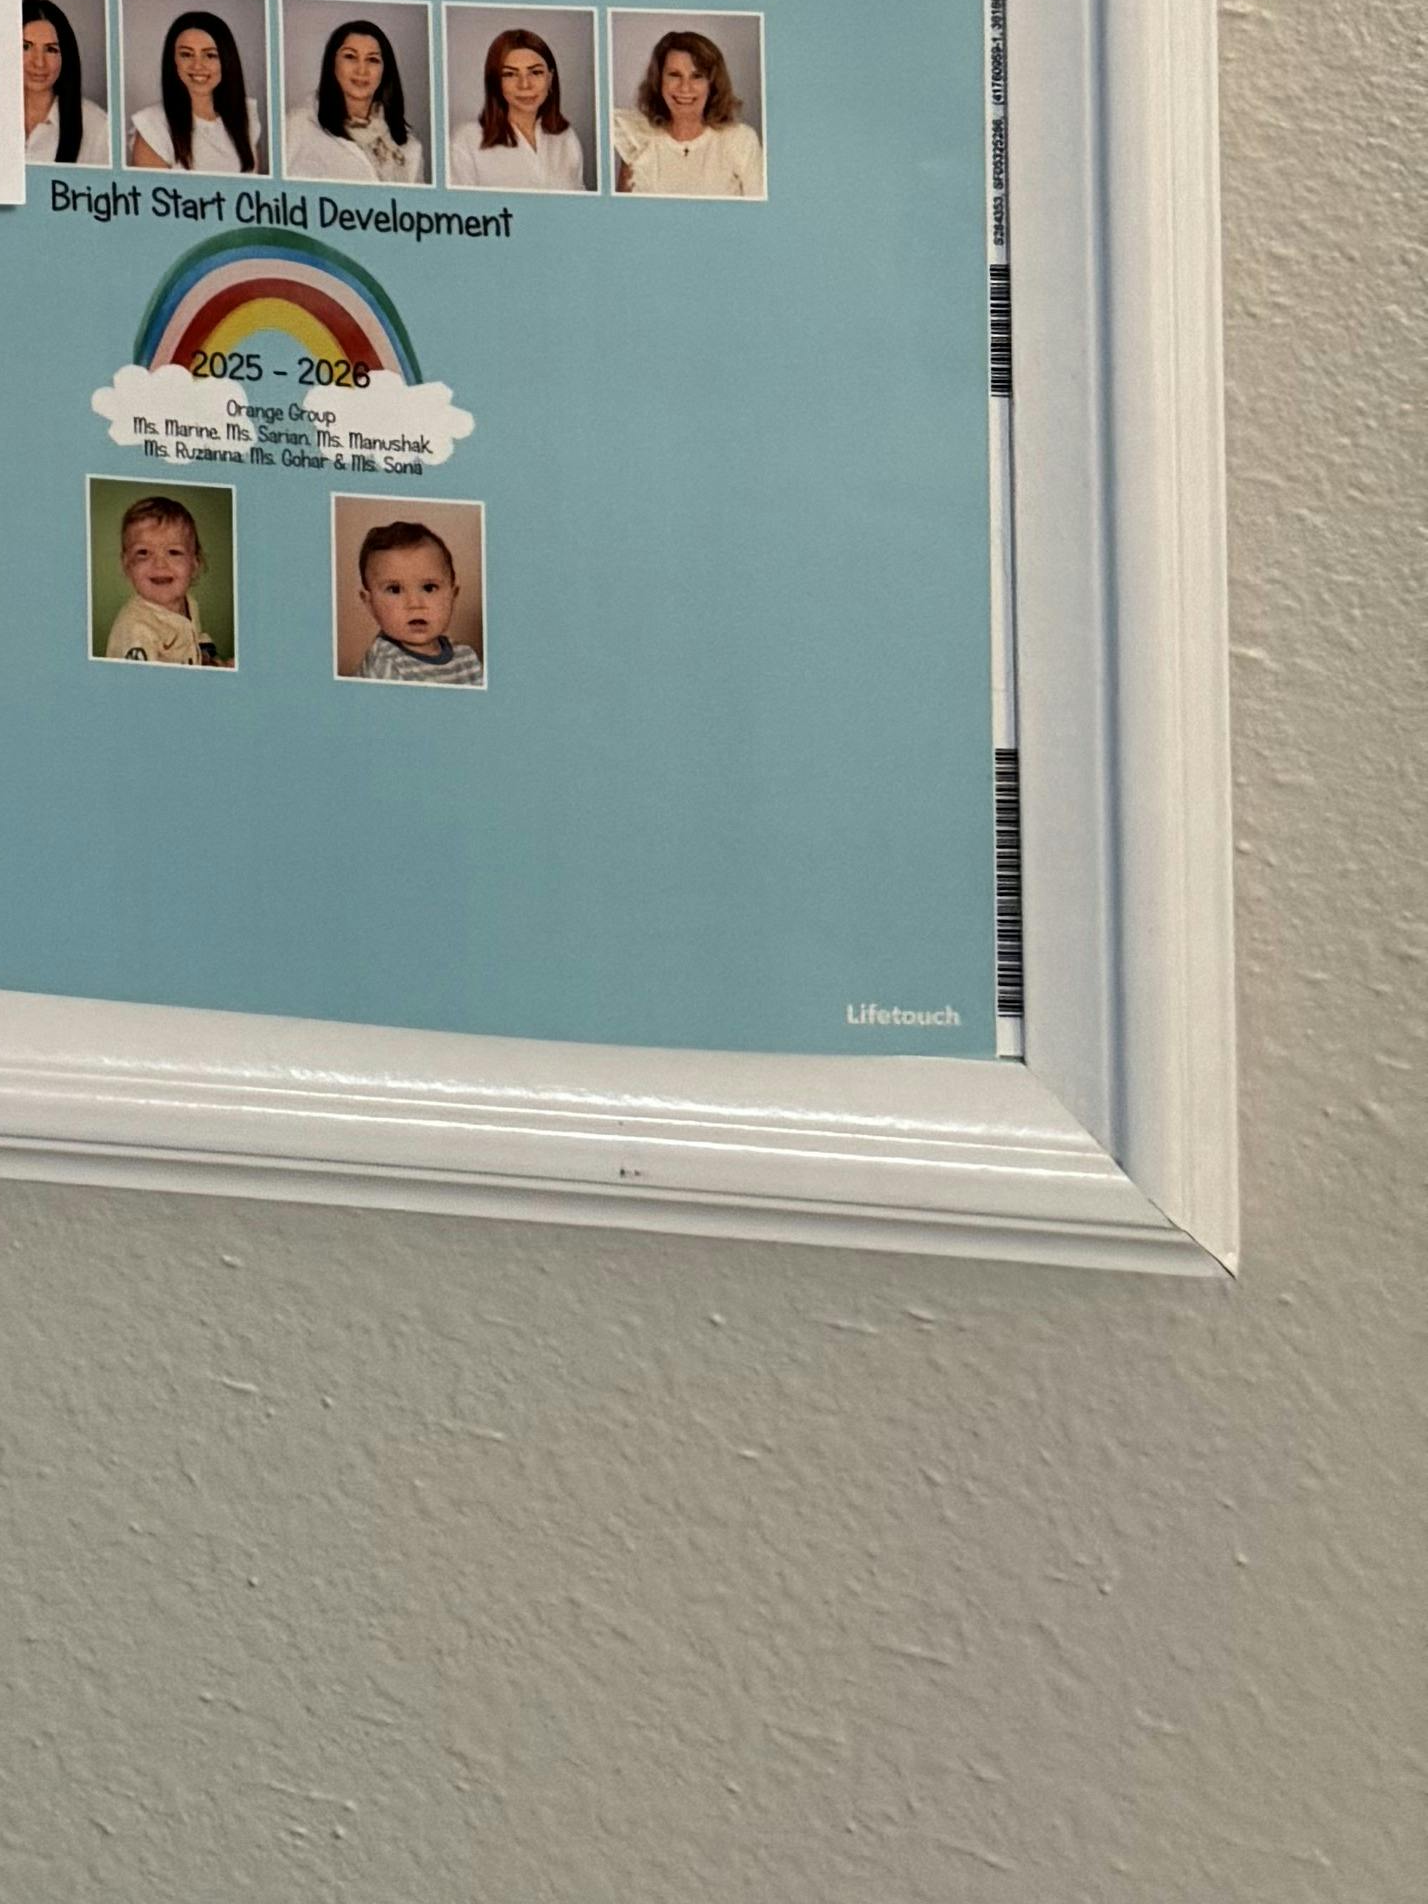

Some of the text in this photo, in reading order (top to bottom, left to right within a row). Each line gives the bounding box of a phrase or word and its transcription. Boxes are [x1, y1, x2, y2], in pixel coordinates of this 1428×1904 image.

[50, 178, 513, 243] Bright Start Child Development
[191, 351, 265, 381] 2025
[297, 356, 372, 389] 2026
[226, 399, 337, 427] Orange Group
[846, 1003, 962, 1027] Lifetouch
